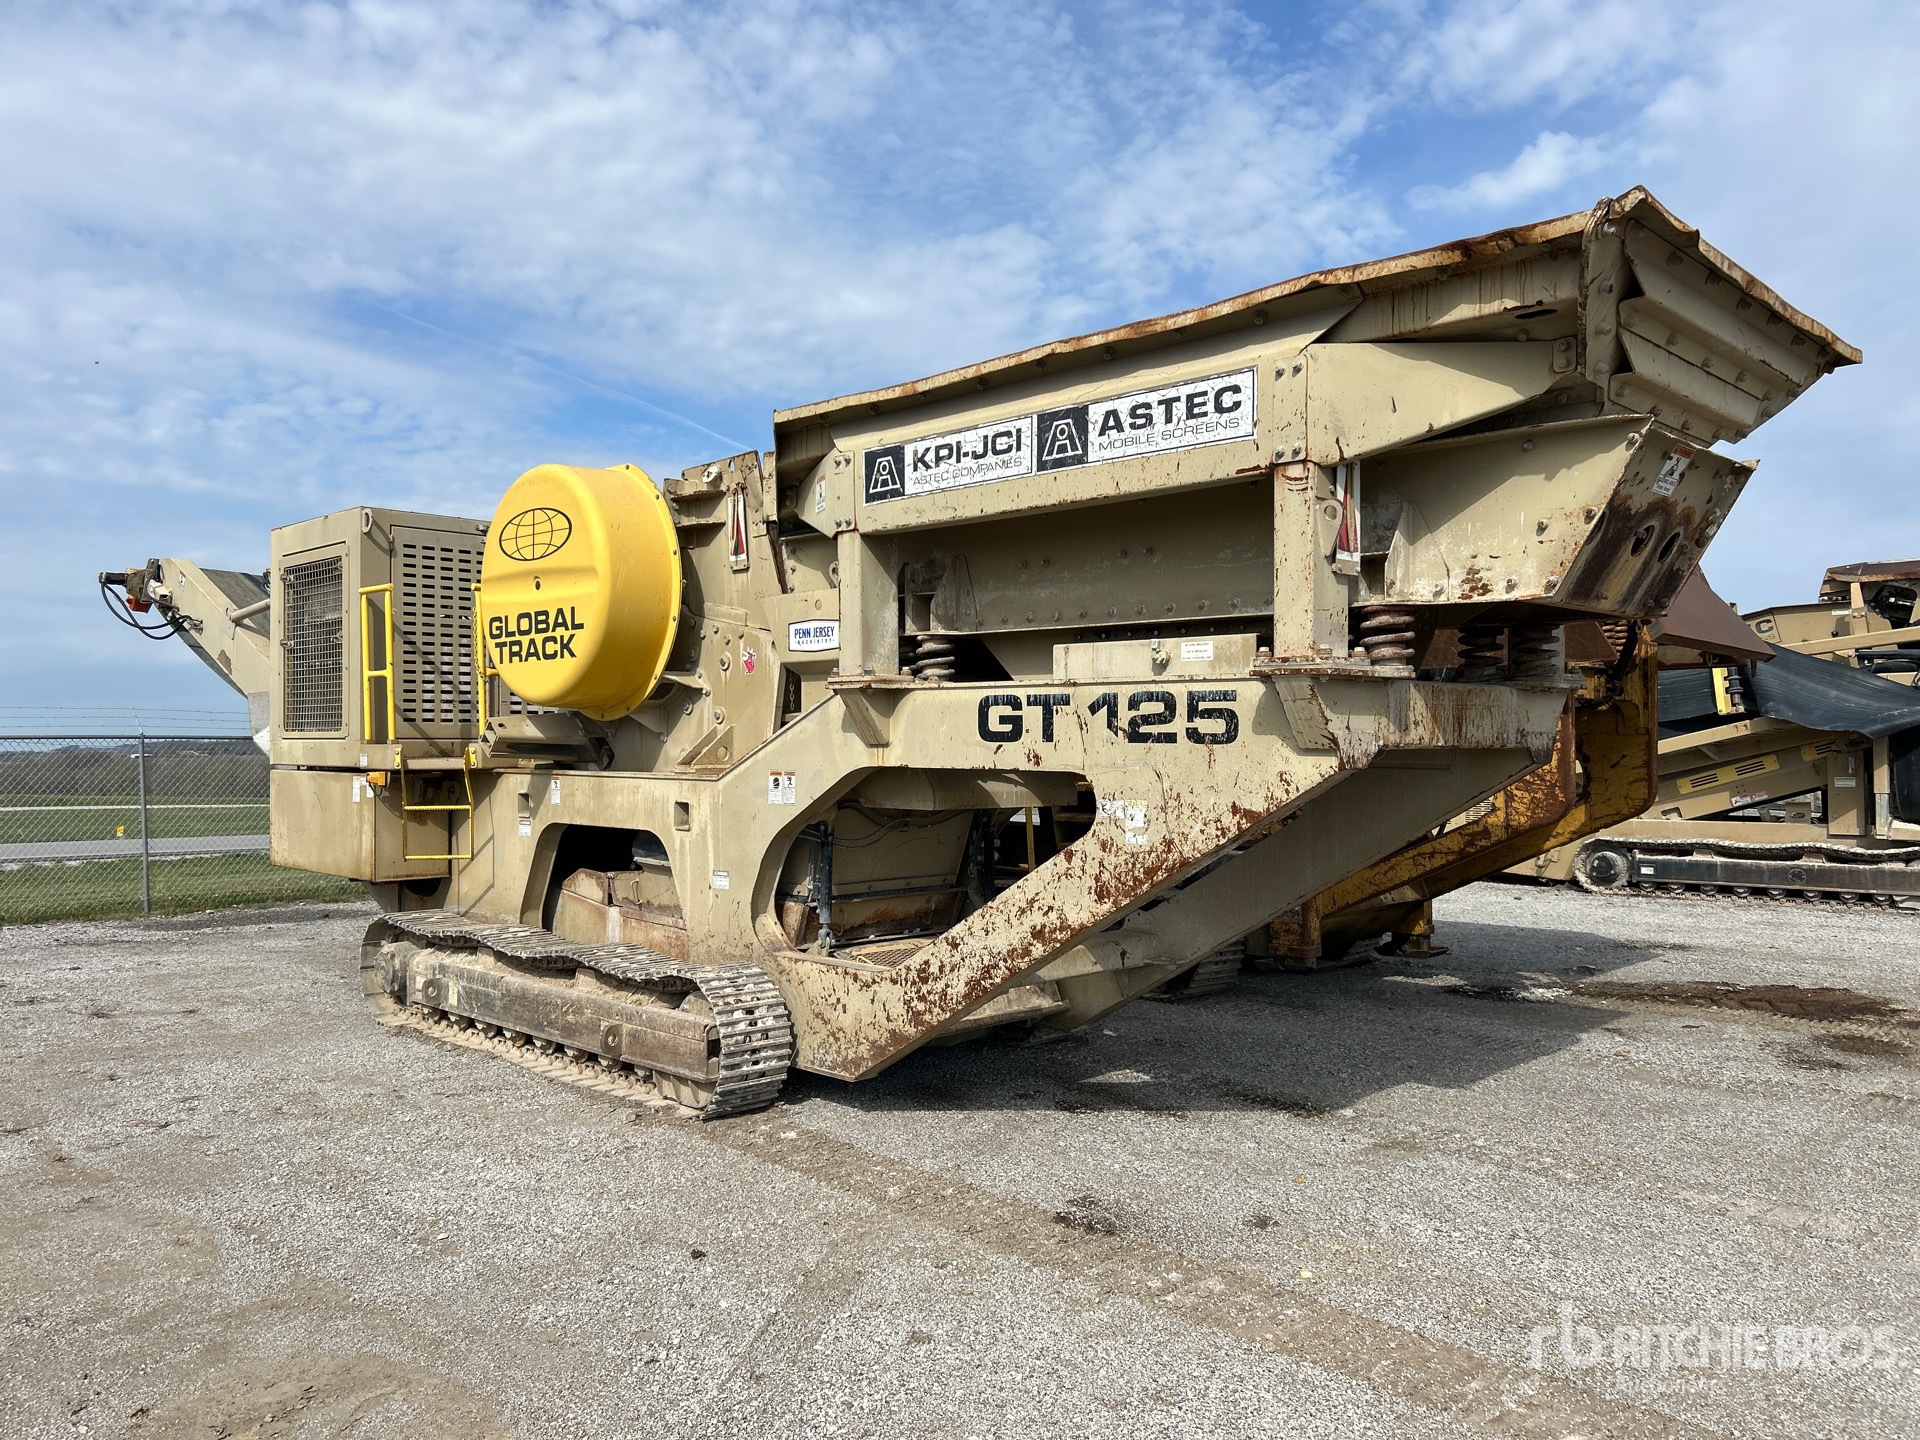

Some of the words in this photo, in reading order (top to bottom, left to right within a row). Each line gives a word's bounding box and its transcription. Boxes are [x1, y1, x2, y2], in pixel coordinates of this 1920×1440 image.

[1097, 384, 1242, 437] ASTEC
[911, 427, 1023, 473] KPI-JCI
[1097, 434, 1156, 452] MOBILE
[1161, 417, 1239, 439] SCREENS
[912, 473, 949, 487] ASTEC
[952, 455, 1023, 478] COMPANIES
[488, 605, 585, 640] GLOBAL
[795, 628, 811, 639] PENN
[812, 626, 834, 638] JERSEY
[494, 633, 577, 665] TRACK
[977, 693, 1070, 743] GT
[1087, 690, 1239, 745] 125
